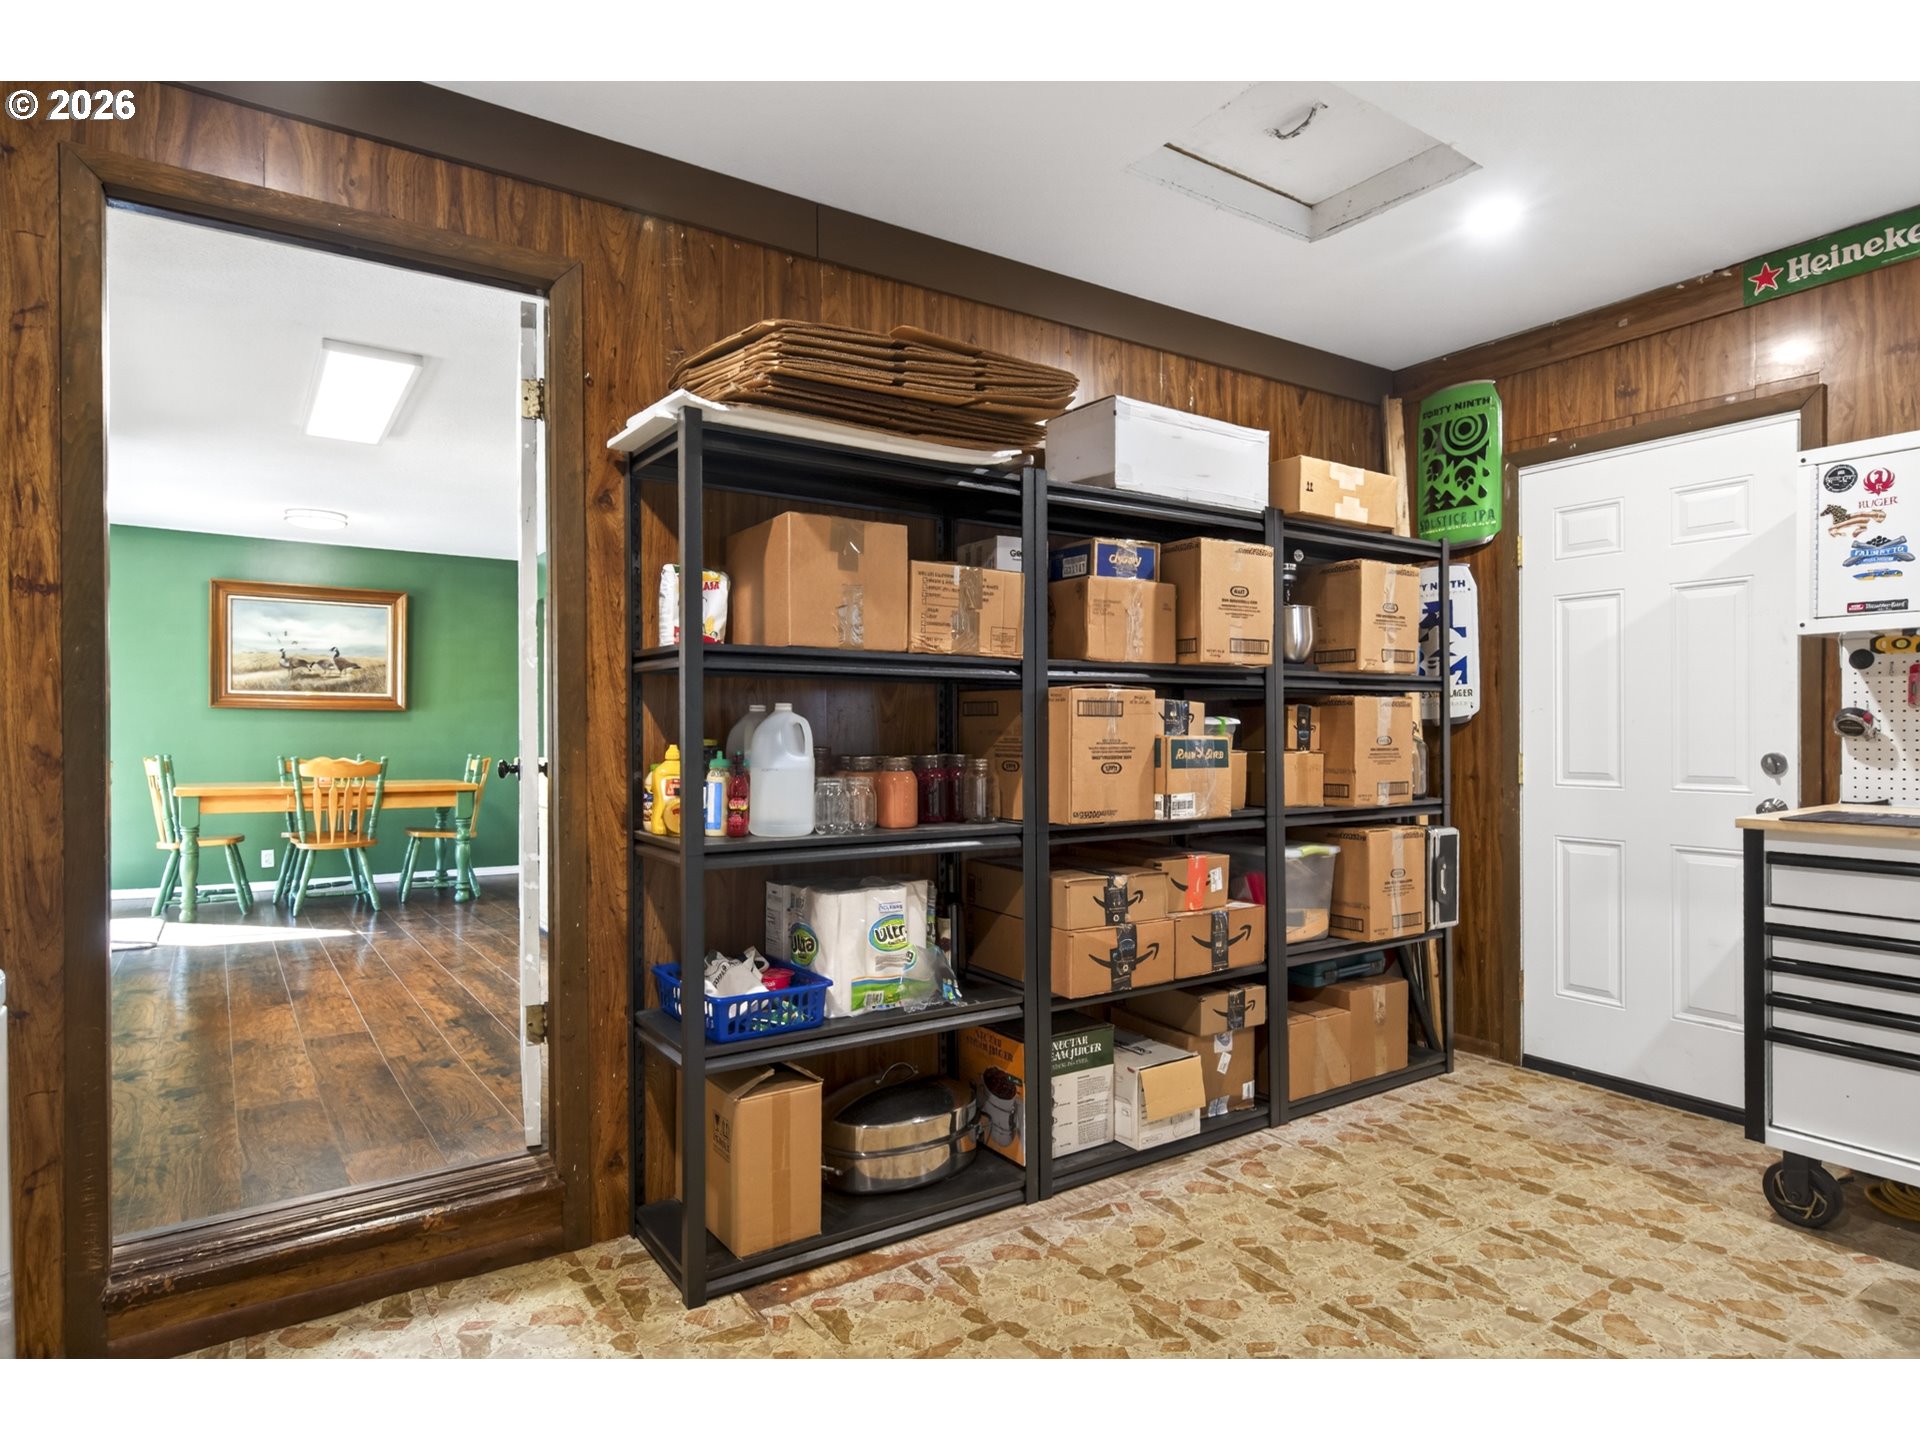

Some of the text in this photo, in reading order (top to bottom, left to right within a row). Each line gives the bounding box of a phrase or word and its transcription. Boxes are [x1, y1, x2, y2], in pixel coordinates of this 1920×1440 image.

[1786, 223, 1920, 283] Heineke
[1422, 396, 1490, 420] FORTY NINTH
[1858, 496, 1898, 509] RUGER
[1420, 511, 1467, 532] SOLSTICE
[1473, 508, 1495, 523] IPA
[874, 924, 908, 943] Ultr
